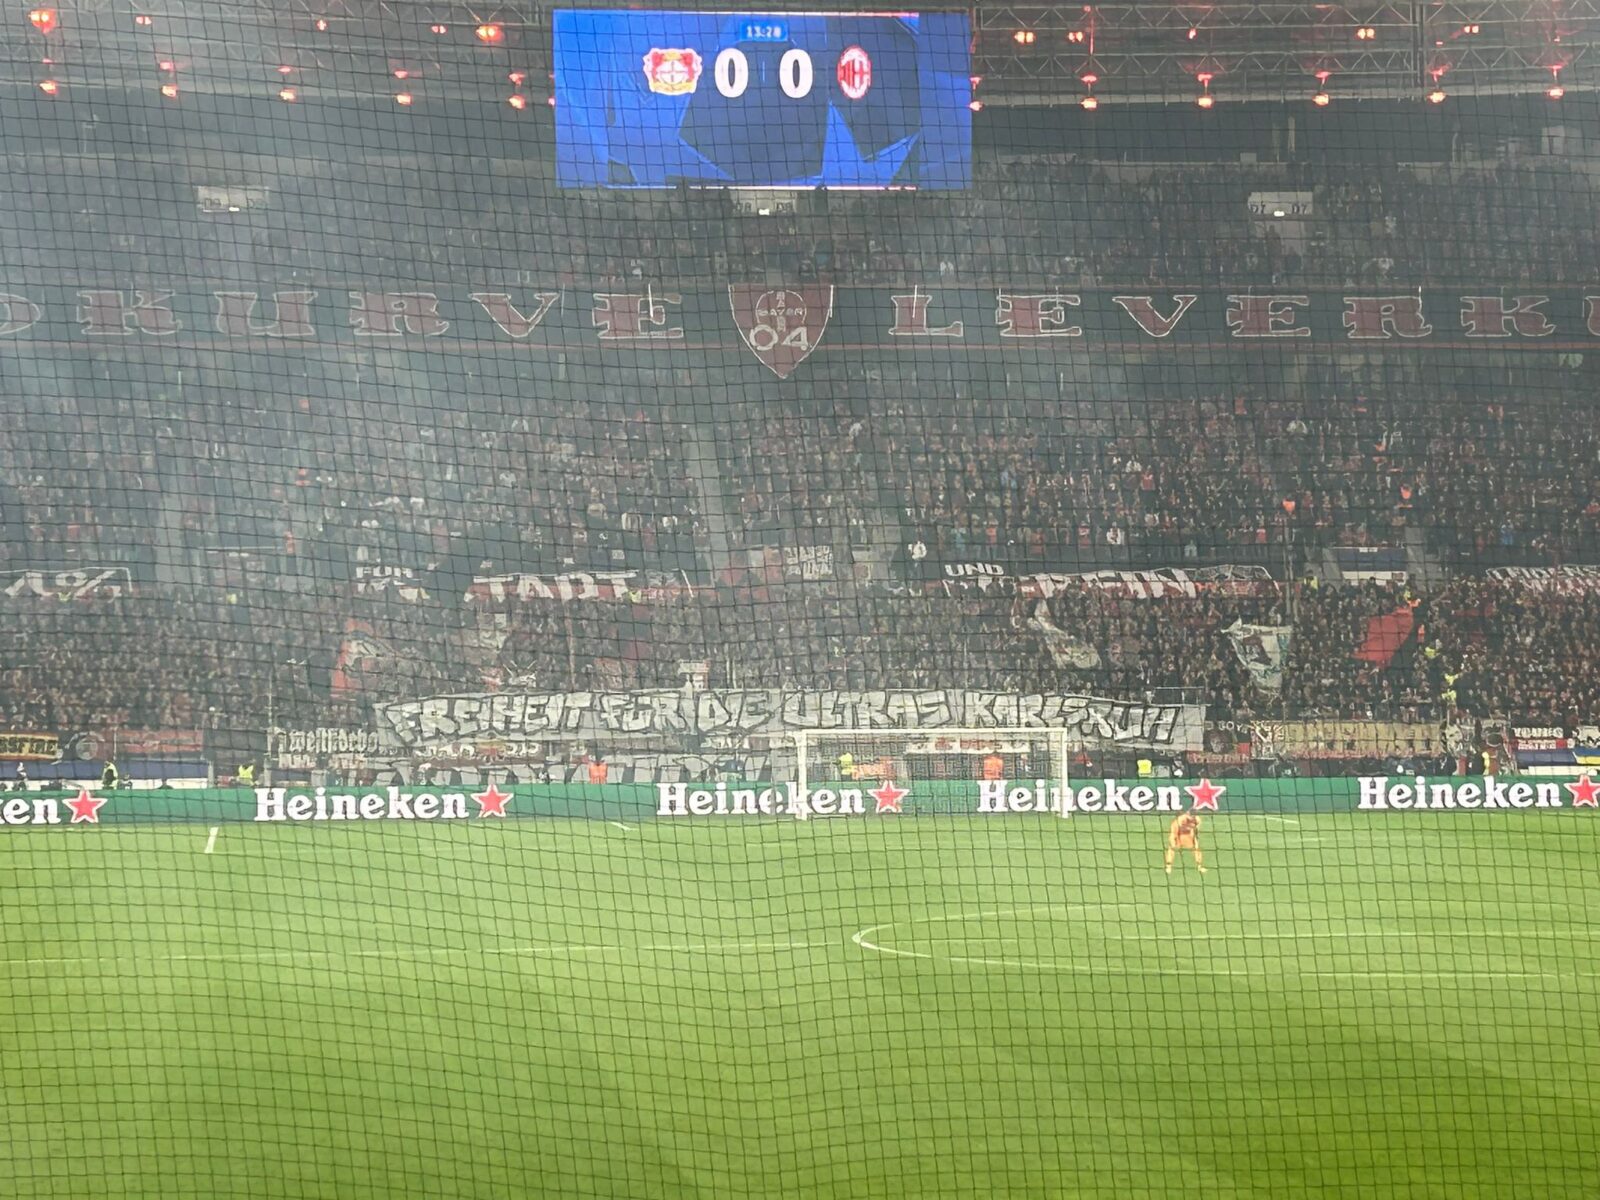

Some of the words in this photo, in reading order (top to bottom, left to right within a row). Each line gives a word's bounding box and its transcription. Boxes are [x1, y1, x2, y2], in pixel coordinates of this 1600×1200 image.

[714, 47, 749, 98] 0
[779, 48, 814, 99] 0
[889, 293, 1600, 338] LEVERK
[749, 324, 809, 351] 04
[782, 689, 953, 729] ULTRAS
[254, 786, 469, 821] Heineken
[656, 782, 866, 816] Heineken
[977, 779, 1183, 813] Heineken
[1357, 775, 1564, 809] Heineken
[0, 798, 61, 824] en
